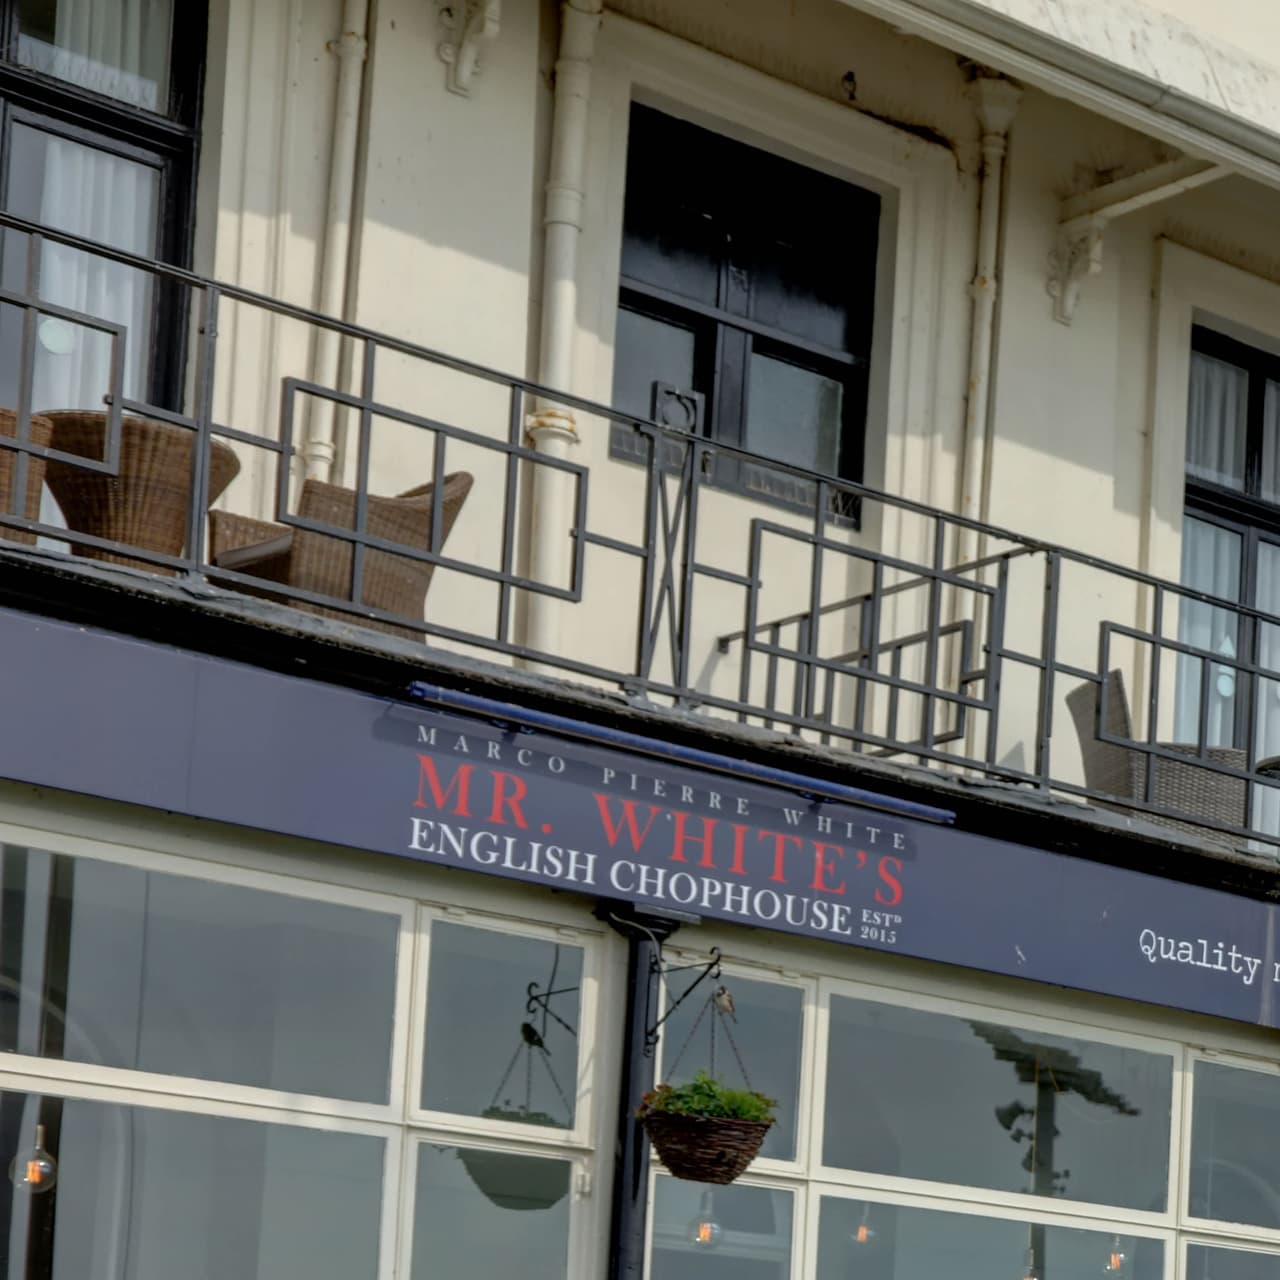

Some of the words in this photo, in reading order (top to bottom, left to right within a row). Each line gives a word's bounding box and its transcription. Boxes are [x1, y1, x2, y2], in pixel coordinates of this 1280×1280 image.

[411, 752, 554, 835] MR.
[592, 791, 905, 908] WHITE'S
[417, 724, 566, 774] MARCO
[603, 767, 750, 816] PIERRE
[783, 807, 906, 851] WHITE
[407, 816, 599, 886] ENGLISH
[609, 859, 853, 936] CHOPHOUSE
[860, 925, 897, 944] 2015
[1139, 928, 1262, 986] Quality
